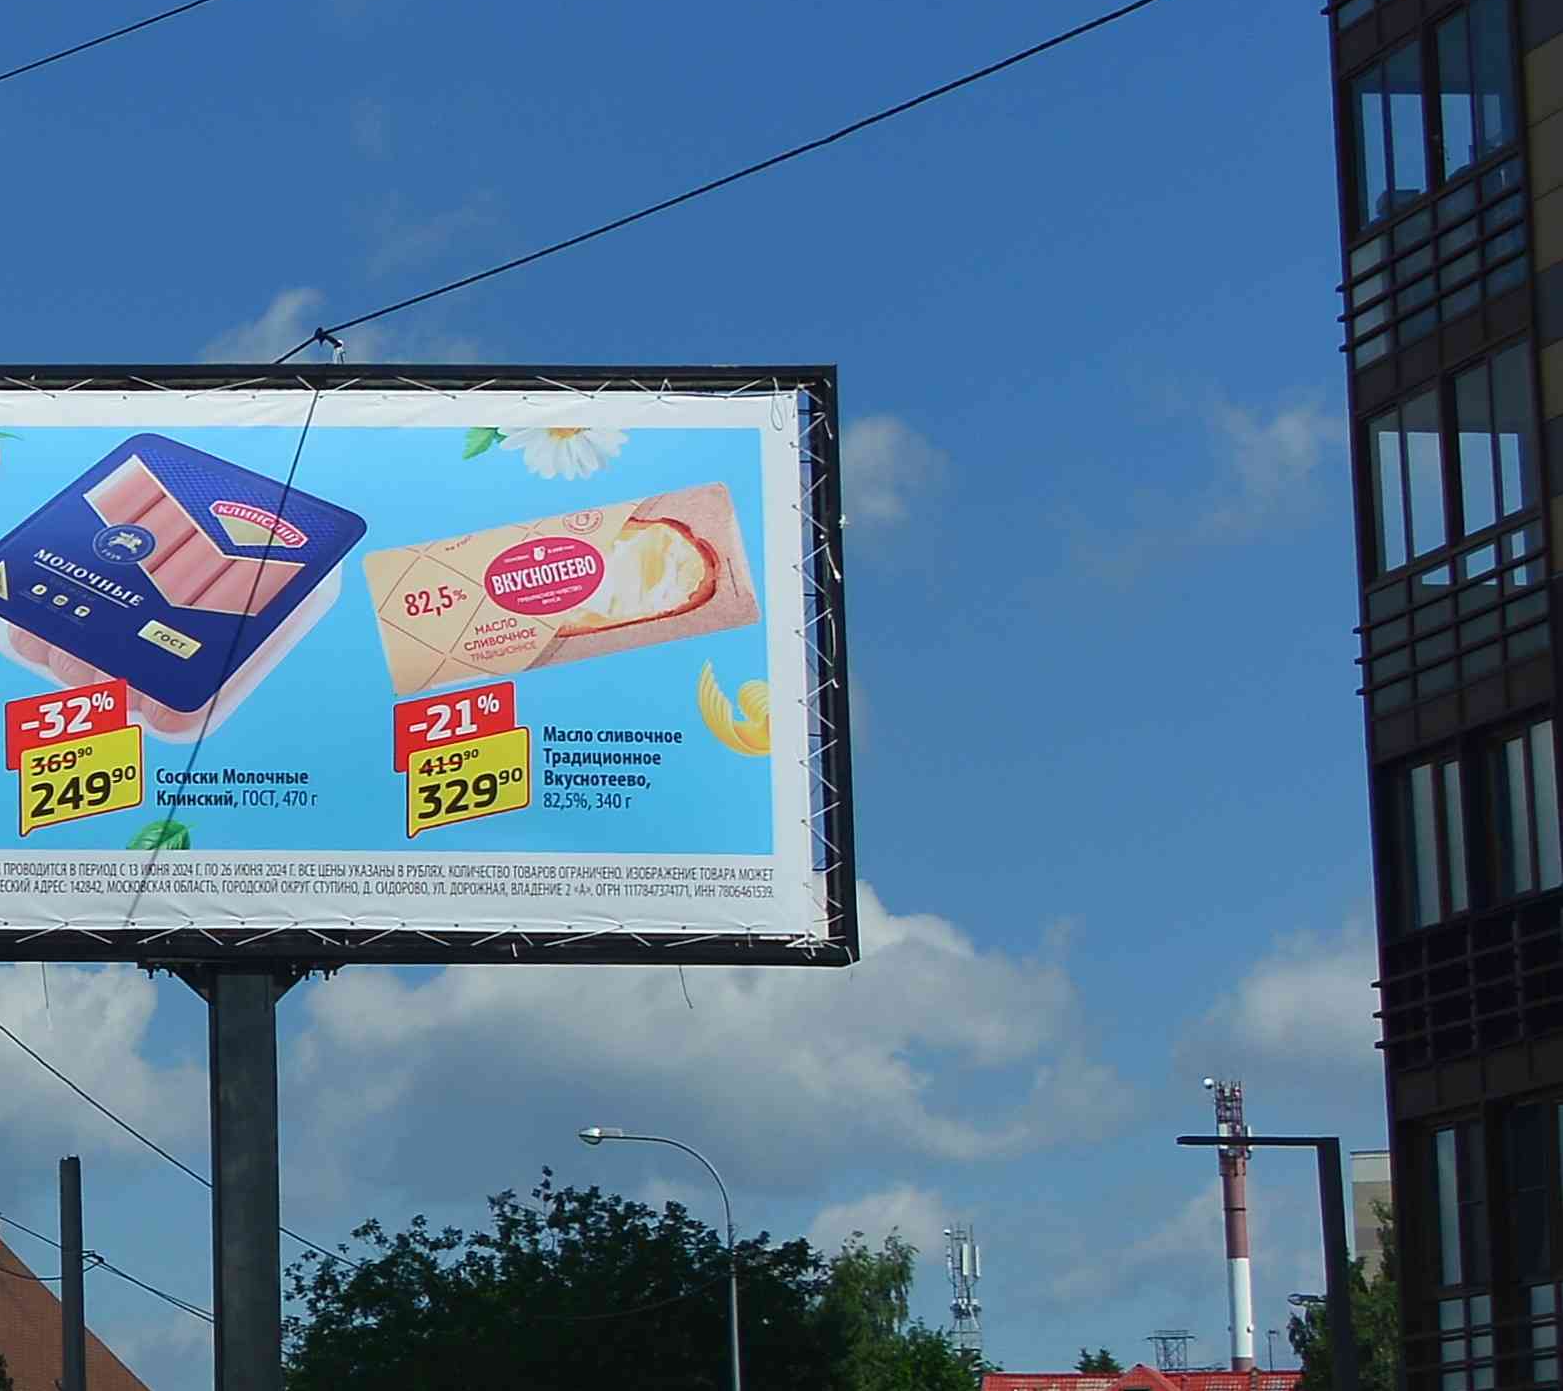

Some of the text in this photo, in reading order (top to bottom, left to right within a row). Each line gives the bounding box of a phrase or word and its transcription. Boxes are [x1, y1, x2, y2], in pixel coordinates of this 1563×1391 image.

[33, 548, 145, 607] МОЛОЧНЫЕ
[491, 555, 597, 595] ВКУСНОТЕЕВО
[475, 617, 518, 636] МАСЛО
[154, 629, 187, 650] ГОСТ
[463, 627, 538, 651] СЛИВОЧНОЕ
[543, 726, 683, 744] Масло сливочное
[543, 748, 662, 766] Традиционное
[156, 768, 309, 785] Сосиски Молочные
[543, 770, 651, 790] Вкуснотеево,
[156, 790, 318, 808] Клинский, ГОСТ, 470 г
[543, 793, 631, 811] 82,5%, 340 г
[4, 862, 67, 876] ПРОВОДИТСЯ
[70, 863, 76, 876] В
[79, 863, 116, 877] ПЕРИОД
[119, 863, 126, 876] С
[129, 863, 138, 876] 13
[172, 863, 193, 876] 2024
[204, 863, 218, 876] ПО
[221, 863, 232, 876] 26
[234, 863, 263, 876] ИЮНЯ
[265, 863, 287, 876] 2024
[298, 863, 315, 877] ВСЕ
[318, 863, 345, 877] ЦЕНЫ
[348, 864, 395, 878] УКАЗАНЫ
[398, 864, 404, 878] В
[449, 865, 510, 879] КОЛИЧЕСТВО
[512, 865, 557, 879] ТОВАРОВ
[626, 866, 697, 881] ИЗОБРАЖЕНИЕ
[699, 867, 735, 881] ТОВАРА
[739, 868, 774, 881] МОЖЕТ
[107, 880, 171, 894] МОСКОВСКАЯ
[222, 879, 278, 894] ГОРОДСКОЙ
[280, 880, 310, 894] ОКРУГ
[511, 882, 562, 897] ВЛАДЕНИЕ
[596, 883, 620, 897] ОГРН
[694, 885, 715, 897] ИНН
